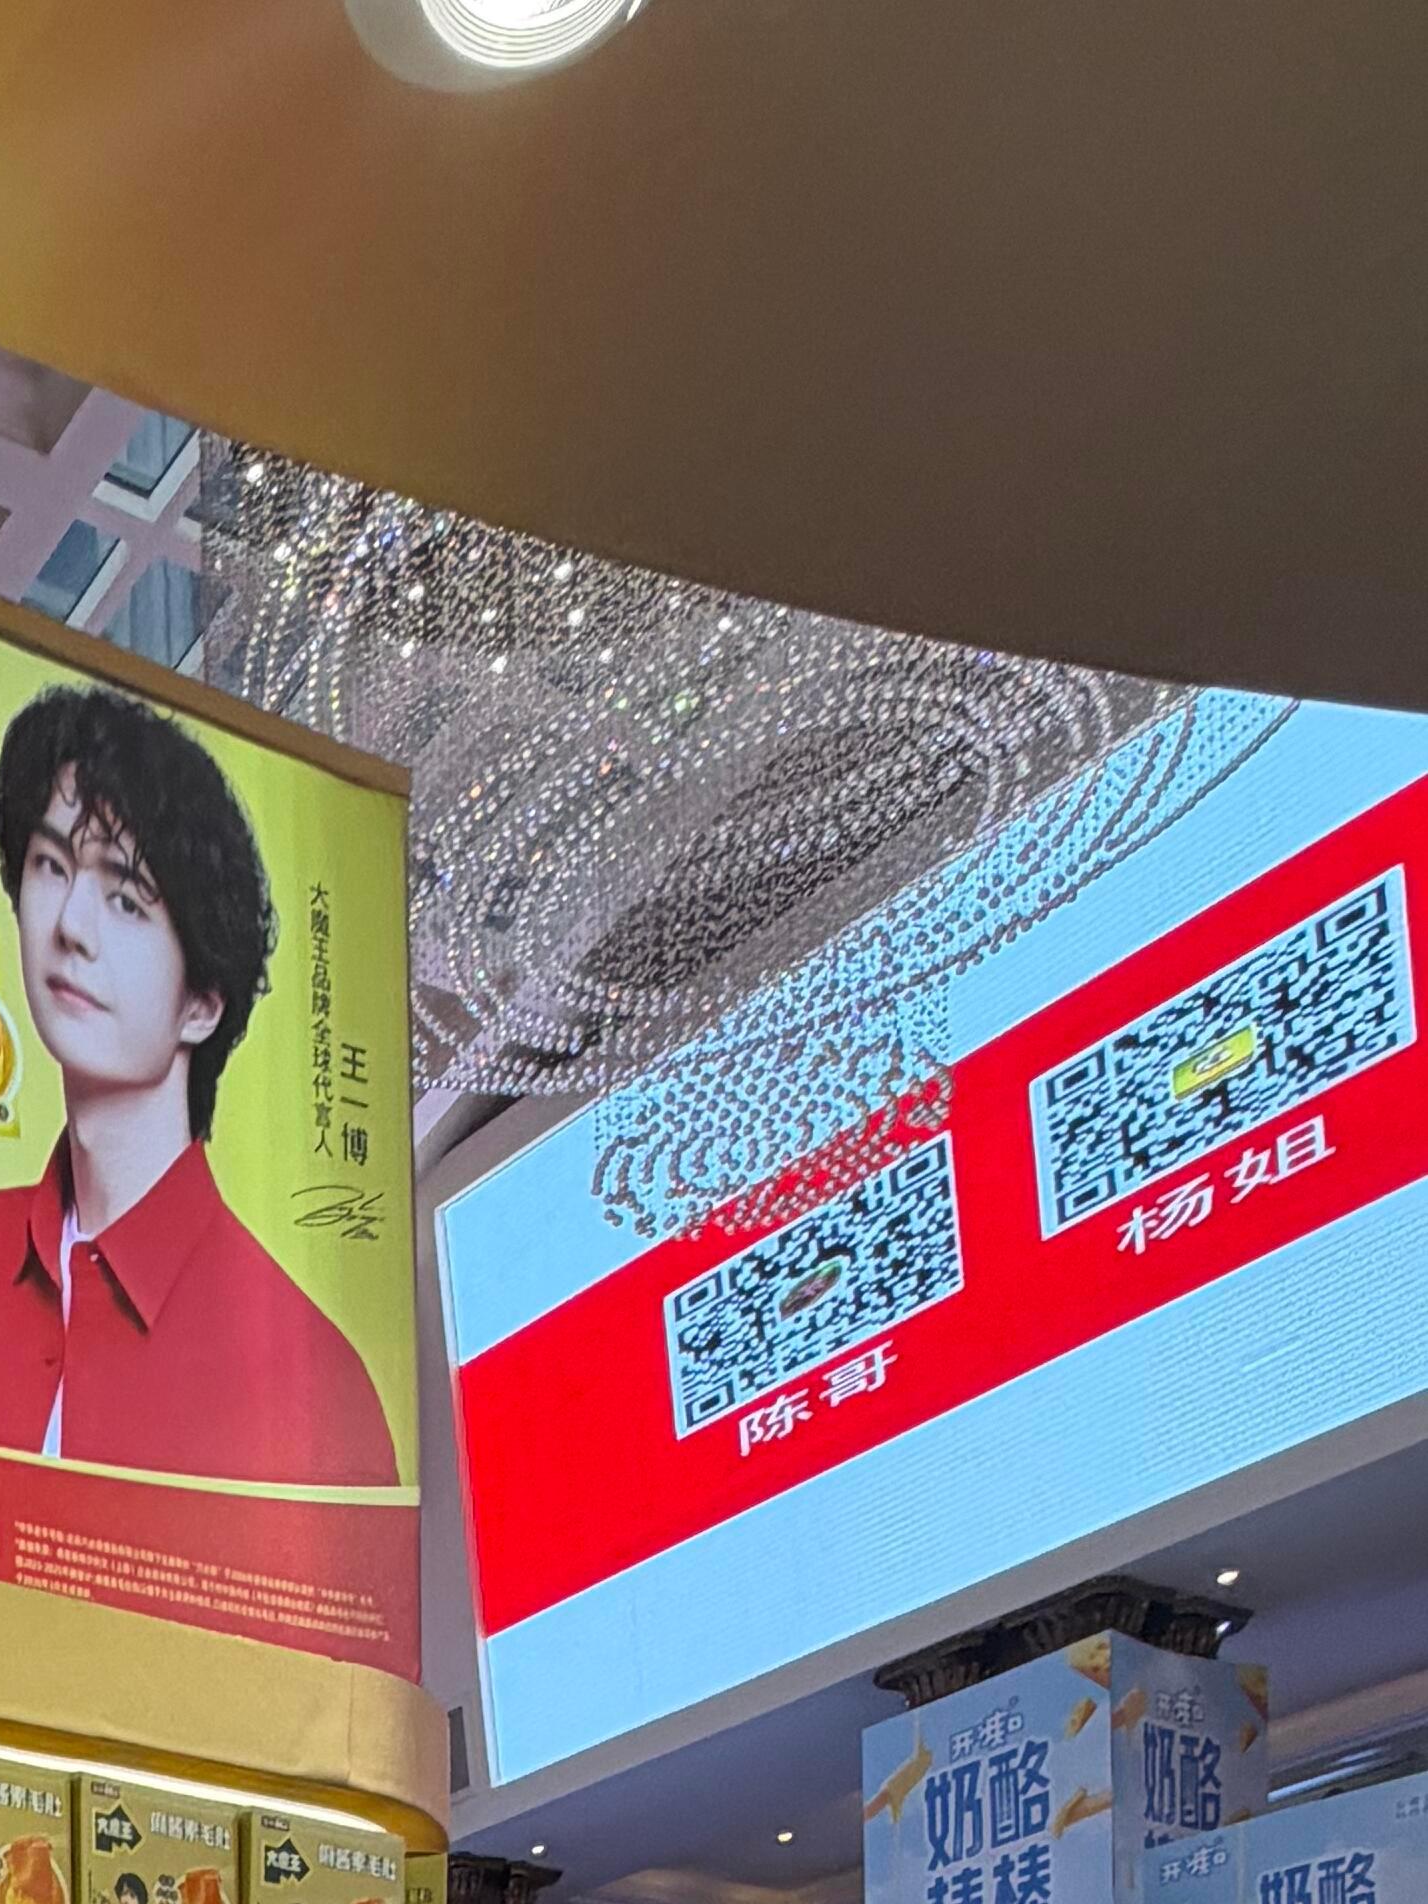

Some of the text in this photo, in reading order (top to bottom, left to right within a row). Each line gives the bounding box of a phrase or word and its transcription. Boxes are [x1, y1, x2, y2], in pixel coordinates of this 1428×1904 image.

[309, 881, 334, 1157] 大魔王品牌全球代言人
[340, 1044, 368, 1167] 王一博
[925, 1739, 1050, 1871] 奶酪
